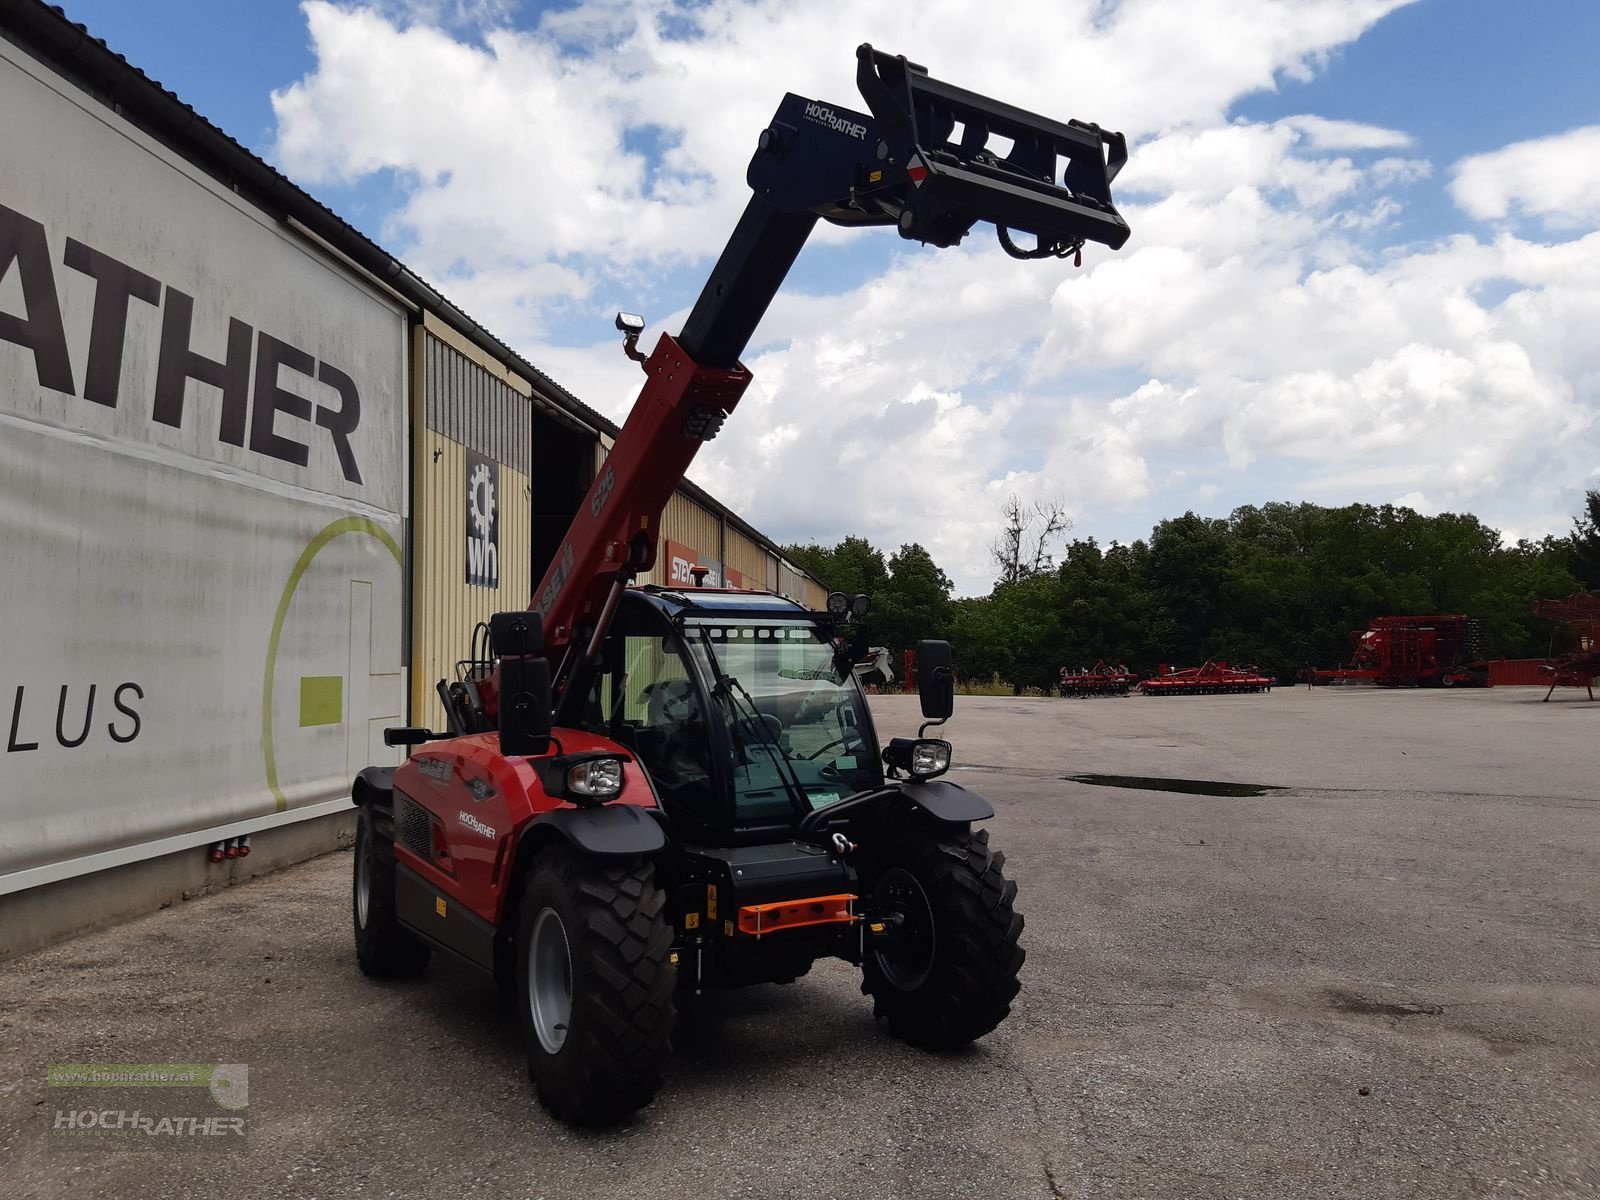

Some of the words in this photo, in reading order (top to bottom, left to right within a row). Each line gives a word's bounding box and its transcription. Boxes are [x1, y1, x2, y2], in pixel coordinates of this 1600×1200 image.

[804, 102, 867, 140] HOCHRATHER
[592, 465, 614, 518] 626
[7, 681, 145, 752] LUS
[459, 810, 496, 840] HOCHRATHER
